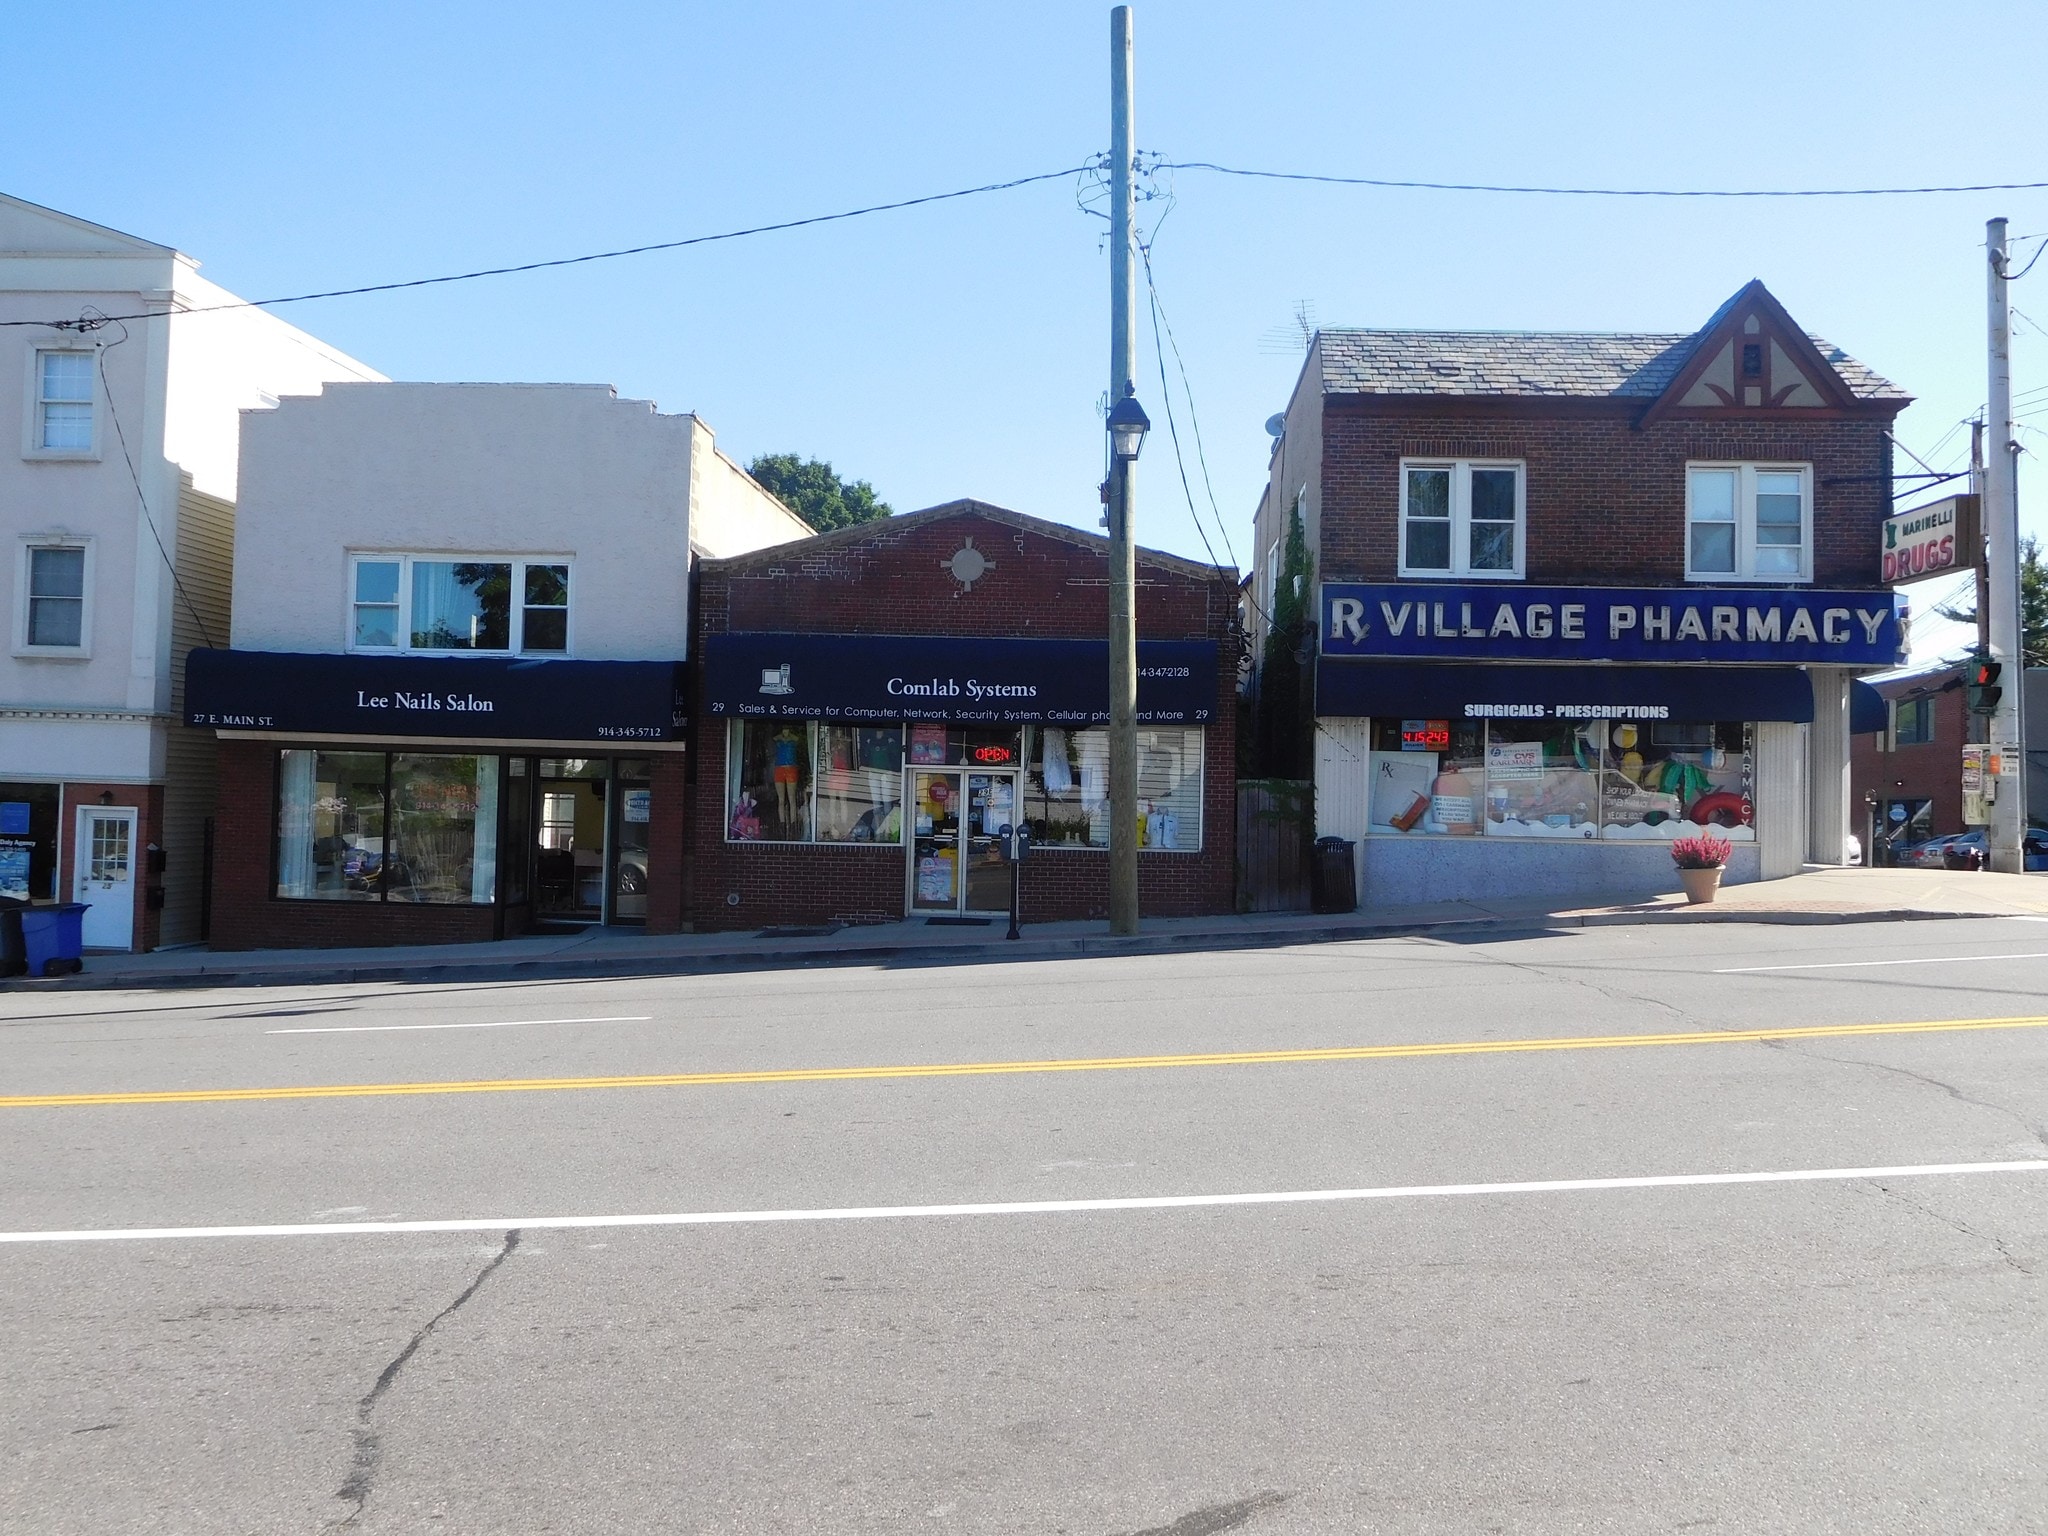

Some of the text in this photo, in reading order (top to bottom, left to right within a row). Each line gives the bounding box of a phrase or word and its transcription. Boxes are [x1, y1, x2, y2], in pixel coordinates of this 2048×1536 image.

[1902, 509, 1952, 537] MARINELLI
[1883, 534, 1954, 581] DRUGS
[1380, 601, 1586, 640] VILLAGE
[1608, 605, 1889, 645] PHARMACY
[1137, 667, 1190, 678] 14-347-2128
[886, 677, 1038, 702] Comlab Systems
[357, 690, 494, 713] Lee Nails Salon
[193, 713, 274, 726] 27 E. MAIN ST.
[712, 702, 725, 712] 29
[738, 703, 765, 715] Sales
[769, 704, 777, 714] &
[782, 704, 821, 716] Service
[825, 705, 840, 716] for
[844, 706, 900, 719] Computer,
[903, 708, 951, 720] Network,
[955, 709, 999, 721] Security
[1004, 710, 1043, 721] System,
[1047, 709, 1087, 720] Cellular
[1137, 710, 1152, 720] nd
[1156, 710, 1184, 720] More
[1195, 709, 1209, 720] 29
[1464, 703, 1545, 718] SURGICALS
[1555, 704, 1669, 719] PRESCRIPTIONS
[598, 725, 661, 738] 914-345-5712
[1426, 732, 1449, 742] 243
[975, 747, 1010, 761] OPEN
[1514, 752, 1535, 760] CVS
[1741, 722, 1753, 826] PHARMACY
